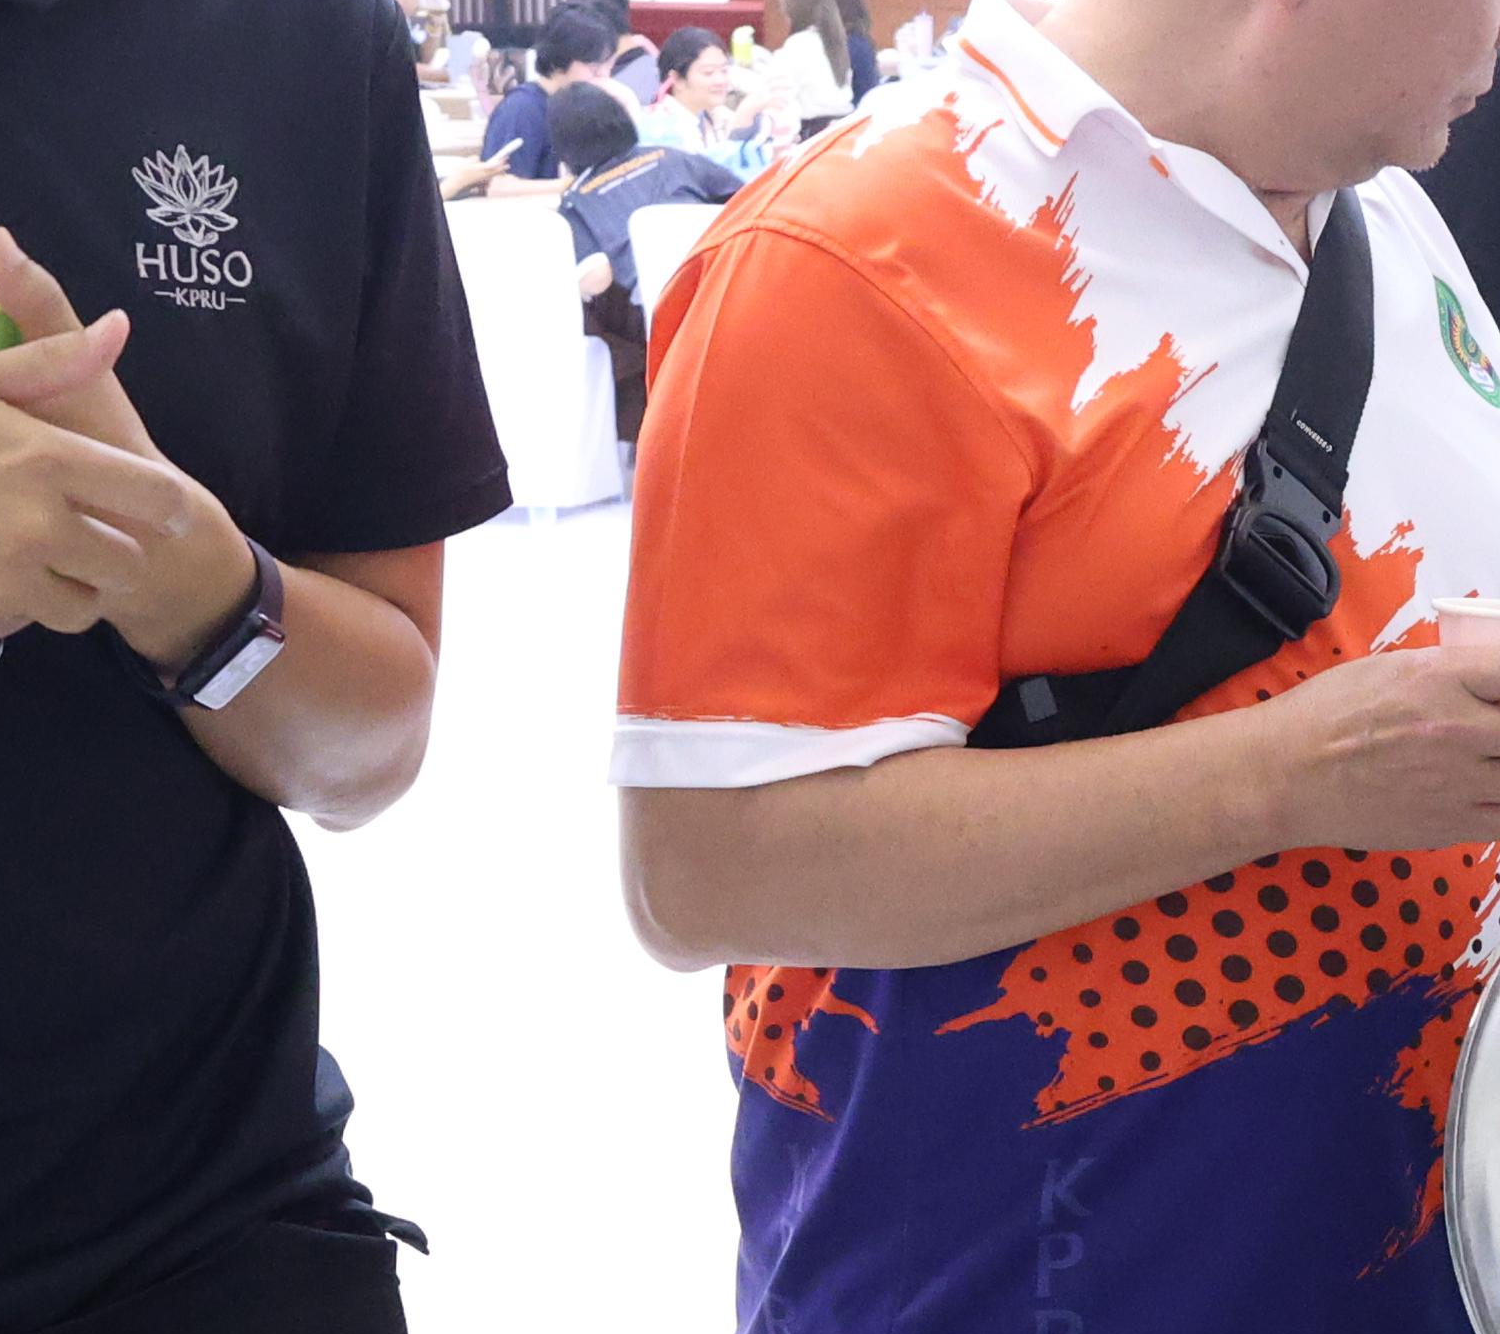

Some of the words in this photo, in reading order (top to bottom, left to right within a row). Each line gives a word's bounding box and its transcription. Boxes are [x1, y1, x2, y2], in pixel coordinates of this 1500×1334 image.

[135, 242, 253, 287] HUSO
[175, 287, 226, 310] KPRU
[1296, 419, 1328, 449] CONVERSE
